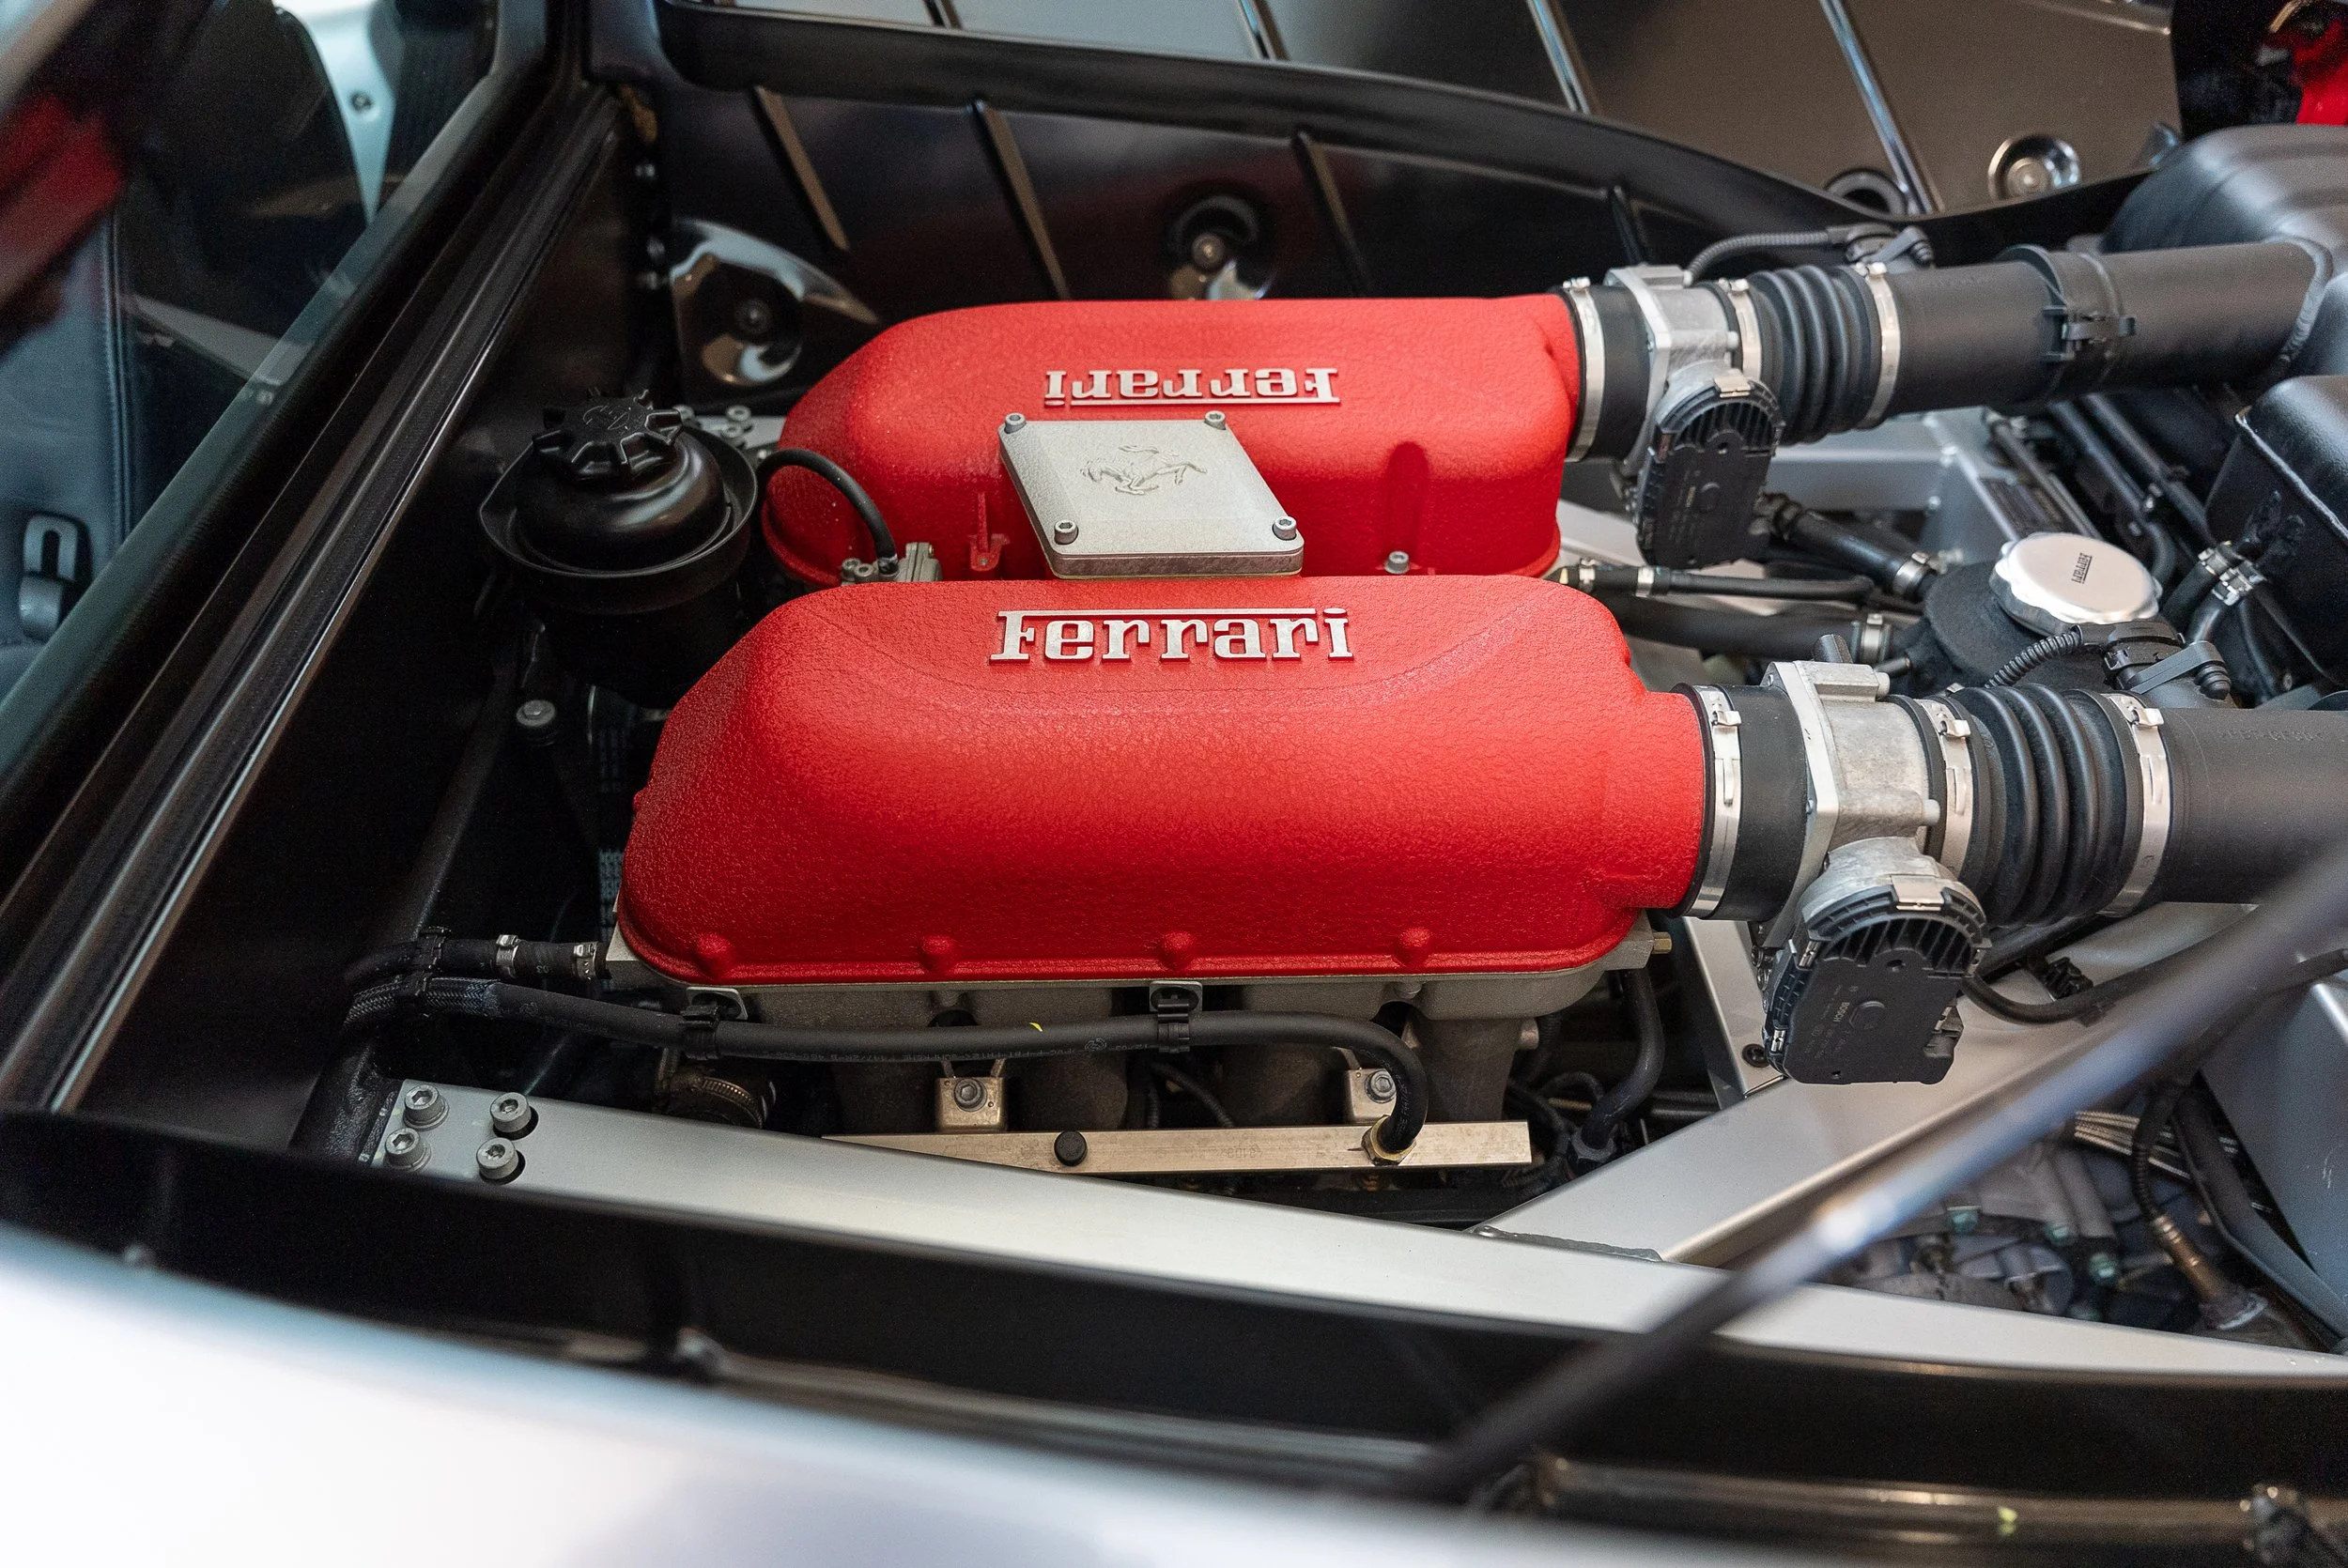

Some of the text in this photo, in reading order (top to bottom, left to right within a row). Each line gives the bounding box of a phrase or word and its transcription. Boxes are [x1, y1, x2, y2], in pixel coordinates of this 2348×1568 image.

[1043, 367, 1341, 407] Ferrari
[2071, 552, 2093, 584] Ferrari
[989, 607, 1354, 665] Ferrari
[1832, 1002, 1850, 1022] BOSCH
